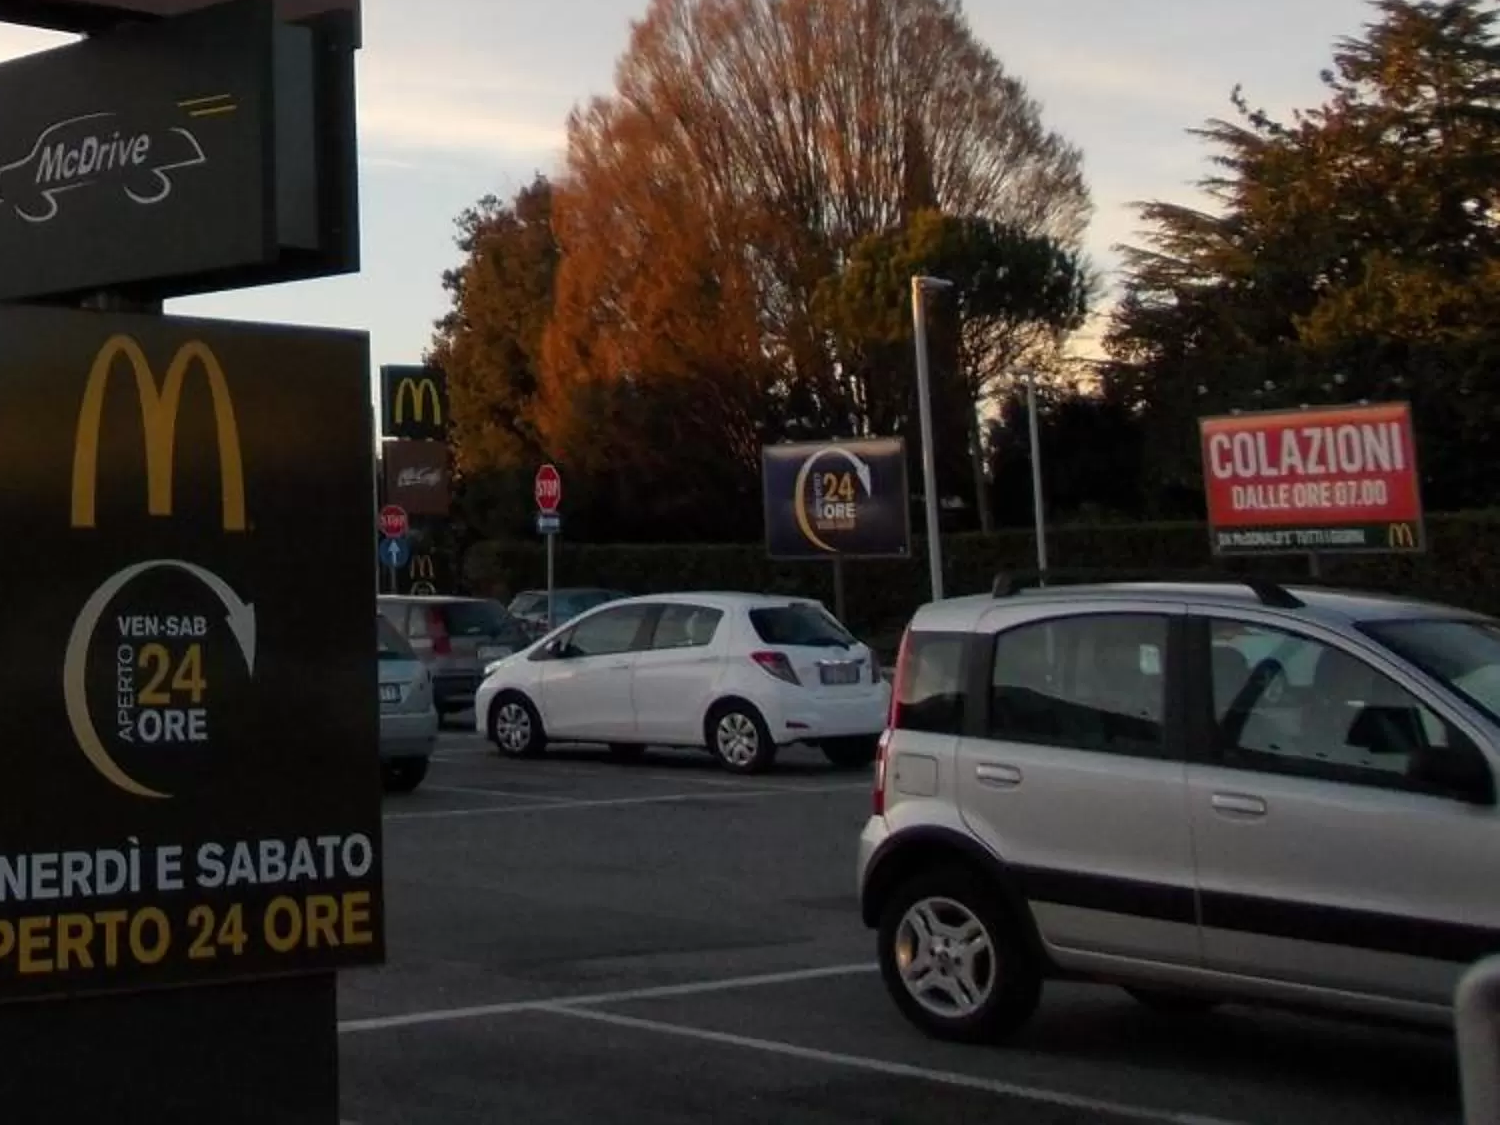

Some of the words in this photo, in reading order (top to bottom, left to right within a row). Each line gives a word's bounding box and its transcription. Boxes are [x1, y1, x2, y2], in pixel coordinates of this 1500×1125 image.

[35, 129, 150, 185] McDrive
[1209, 421, 1404, 479] COLAZIONI
[538, 478, 557, 497] STOP
[823, 472, 855, 502] 24
[823, 502, 857, 520] ORE
[1231, 484, 1289, 510] DALLE
[1292, 481, 1332, 507] ORE
[116, 643, 136, 743] APERTO
[136, 641, 208, 706] 24
[137, 707, 209, 743] ORE
[156, 845, 184, 891] E
[195, 831, 373, 888] SABATO
[186, 902, 249, 960] 24
[262, 889, 374, 953] ORE
